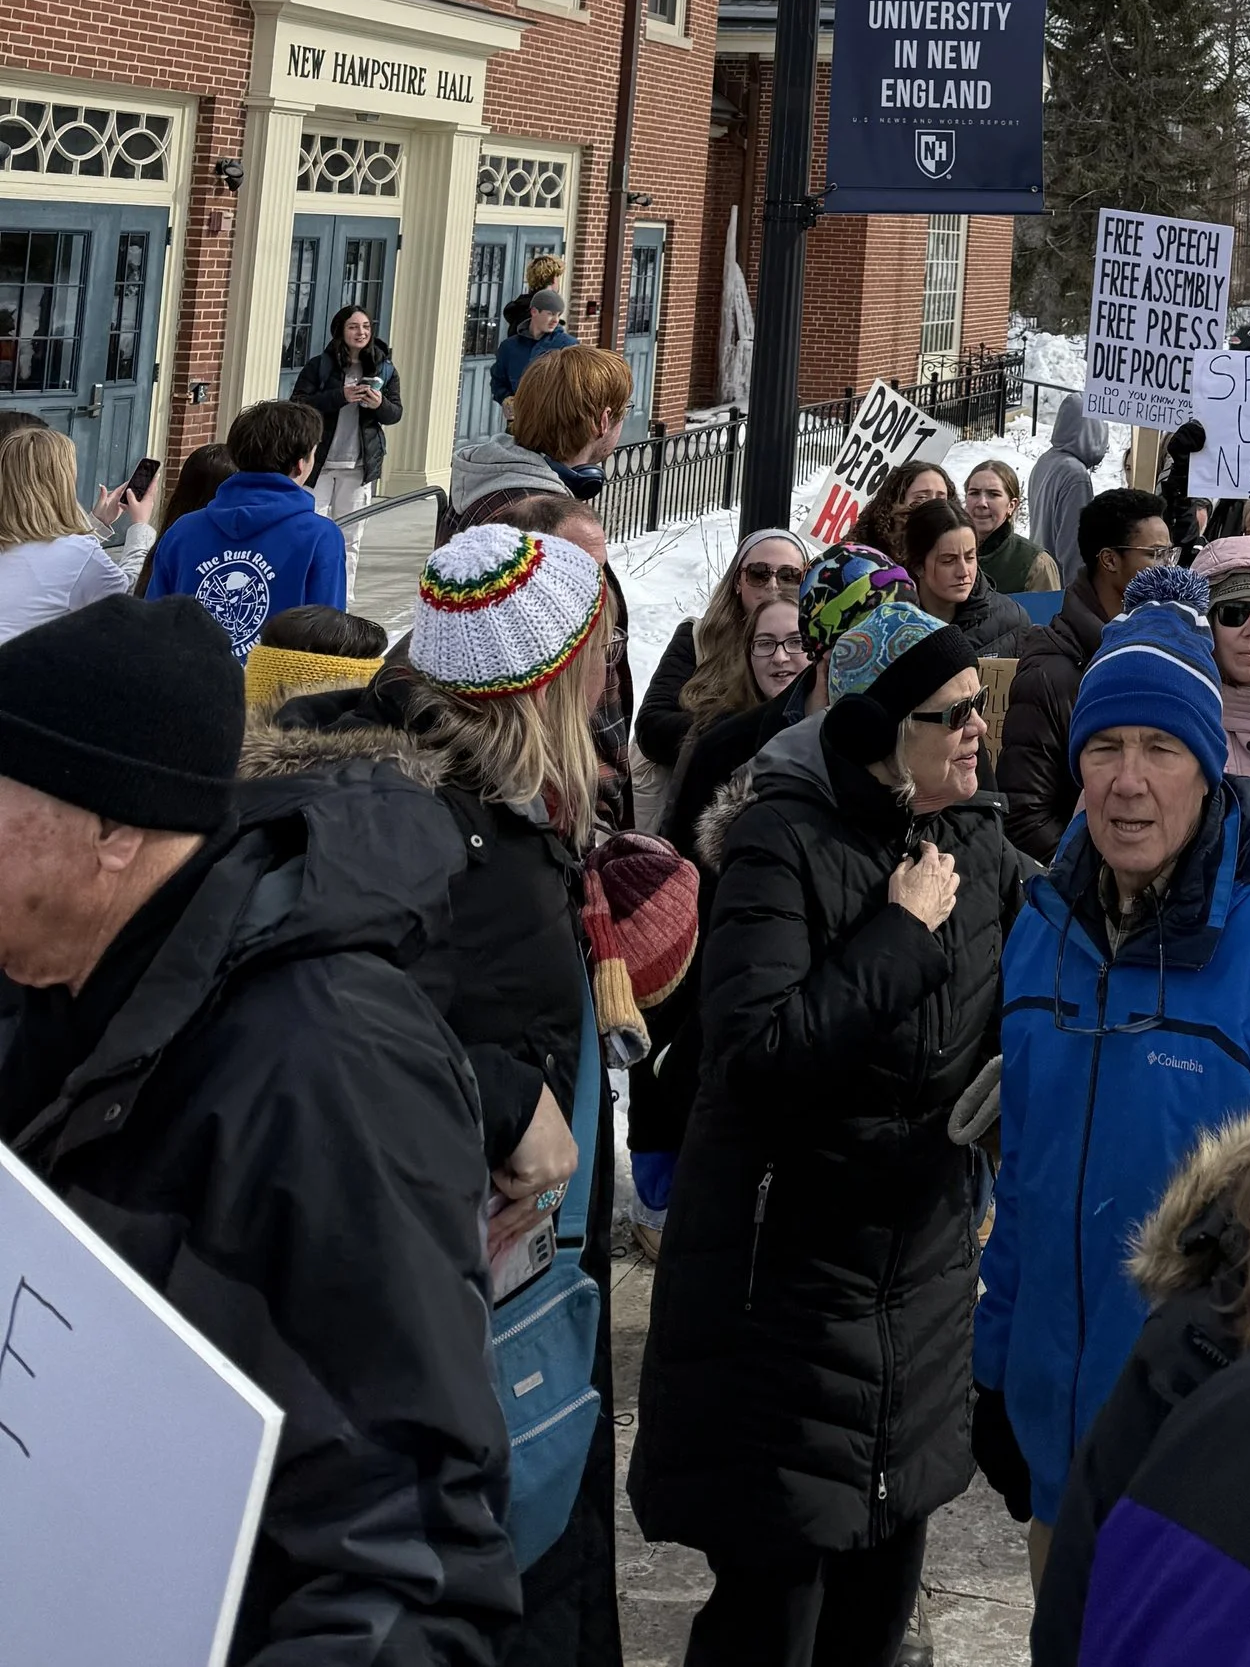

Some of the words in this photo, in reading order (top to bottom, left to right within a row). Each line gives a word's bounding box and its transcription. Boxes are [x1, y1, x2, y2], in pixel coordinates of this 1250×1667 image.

[868, 1, 1011, 31] UNIVERSITY
[286, 43, 327, 80] NEW
[331, 51, 427, 96] HAMPSHIRE
[436, 69, 474, 104] HALL
[894, 40, 917, 68] IN
[927, 41, 981, 70] NEW
[881, 79, 992, 109] ENGLAND
[1102, 216, 1144, 257] FREE
[1152, 224, 1220, 269] SPEECH
[1099, 259, 1141, 299] FREE
[1140, 265, 1226, 313] ASSEMBLY
[1096, 300, 1137, 342] FREE
[1146, 308, 1219, 350] PRESS
[1092, 343, 1127, 384] DUE
[1128, 348, 1192, 395] PROCE
[1087, 393, 1115, 415] BILL
[1119, 400, 1132, 417] OF
[1104, 387, 1120, 397] DO
[1128, 390, 1147, 401] YOU
[1150, 394, 1175, 405] KNOW
[859, 385, 937, 465] DON'T
[834, 433, 891, 497] DEPO
[195, 555, 220, 575] The
[223, 549, 252, 562] Rust
[252, 552, 276, 581] Rats
[252, 582, 267, 625] RATS
[1157, 1052, 1204, 1073] Columbia
